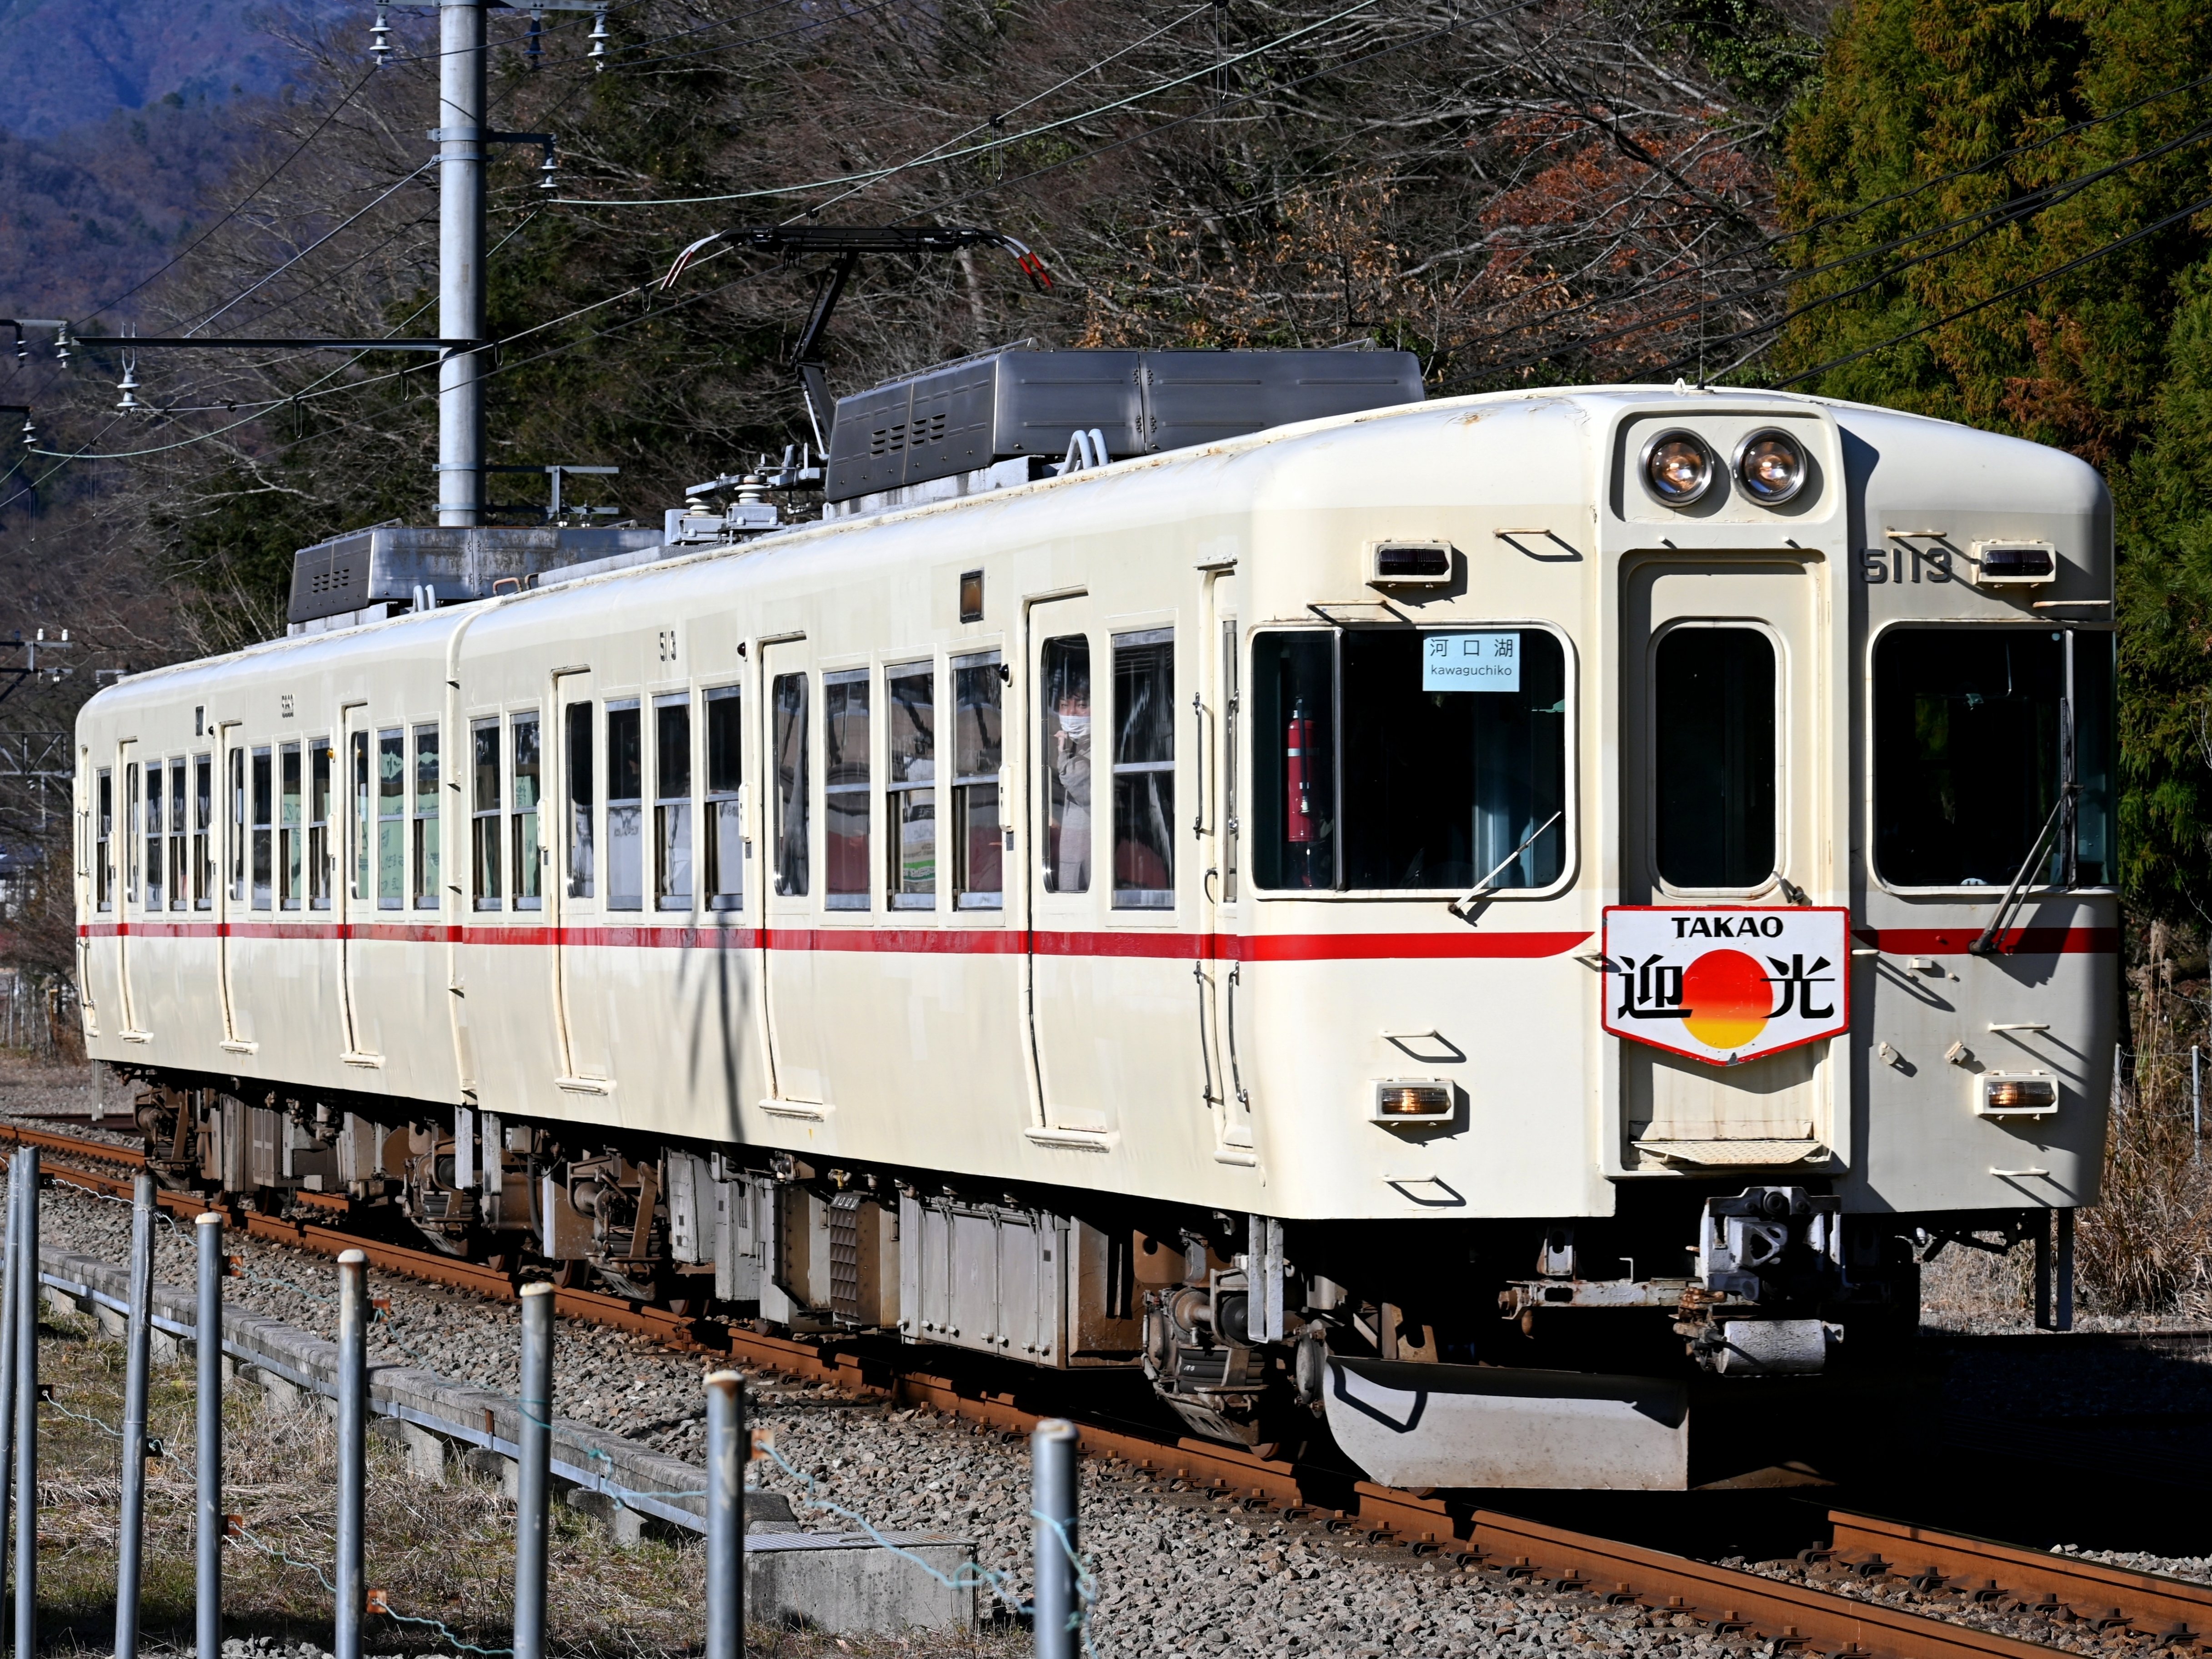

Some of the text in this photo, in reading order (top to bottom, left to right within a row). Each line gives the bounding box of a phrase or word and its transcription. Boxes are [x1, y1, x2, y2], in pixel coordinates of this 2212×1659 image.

[1862, 548, 1951, 583] 5113
[1430, 638, 1513, 657] 河口湖
[1431, 664, 1512, 676] kawaguchiko
[1672, 916, 1783, 938] TAKAO
